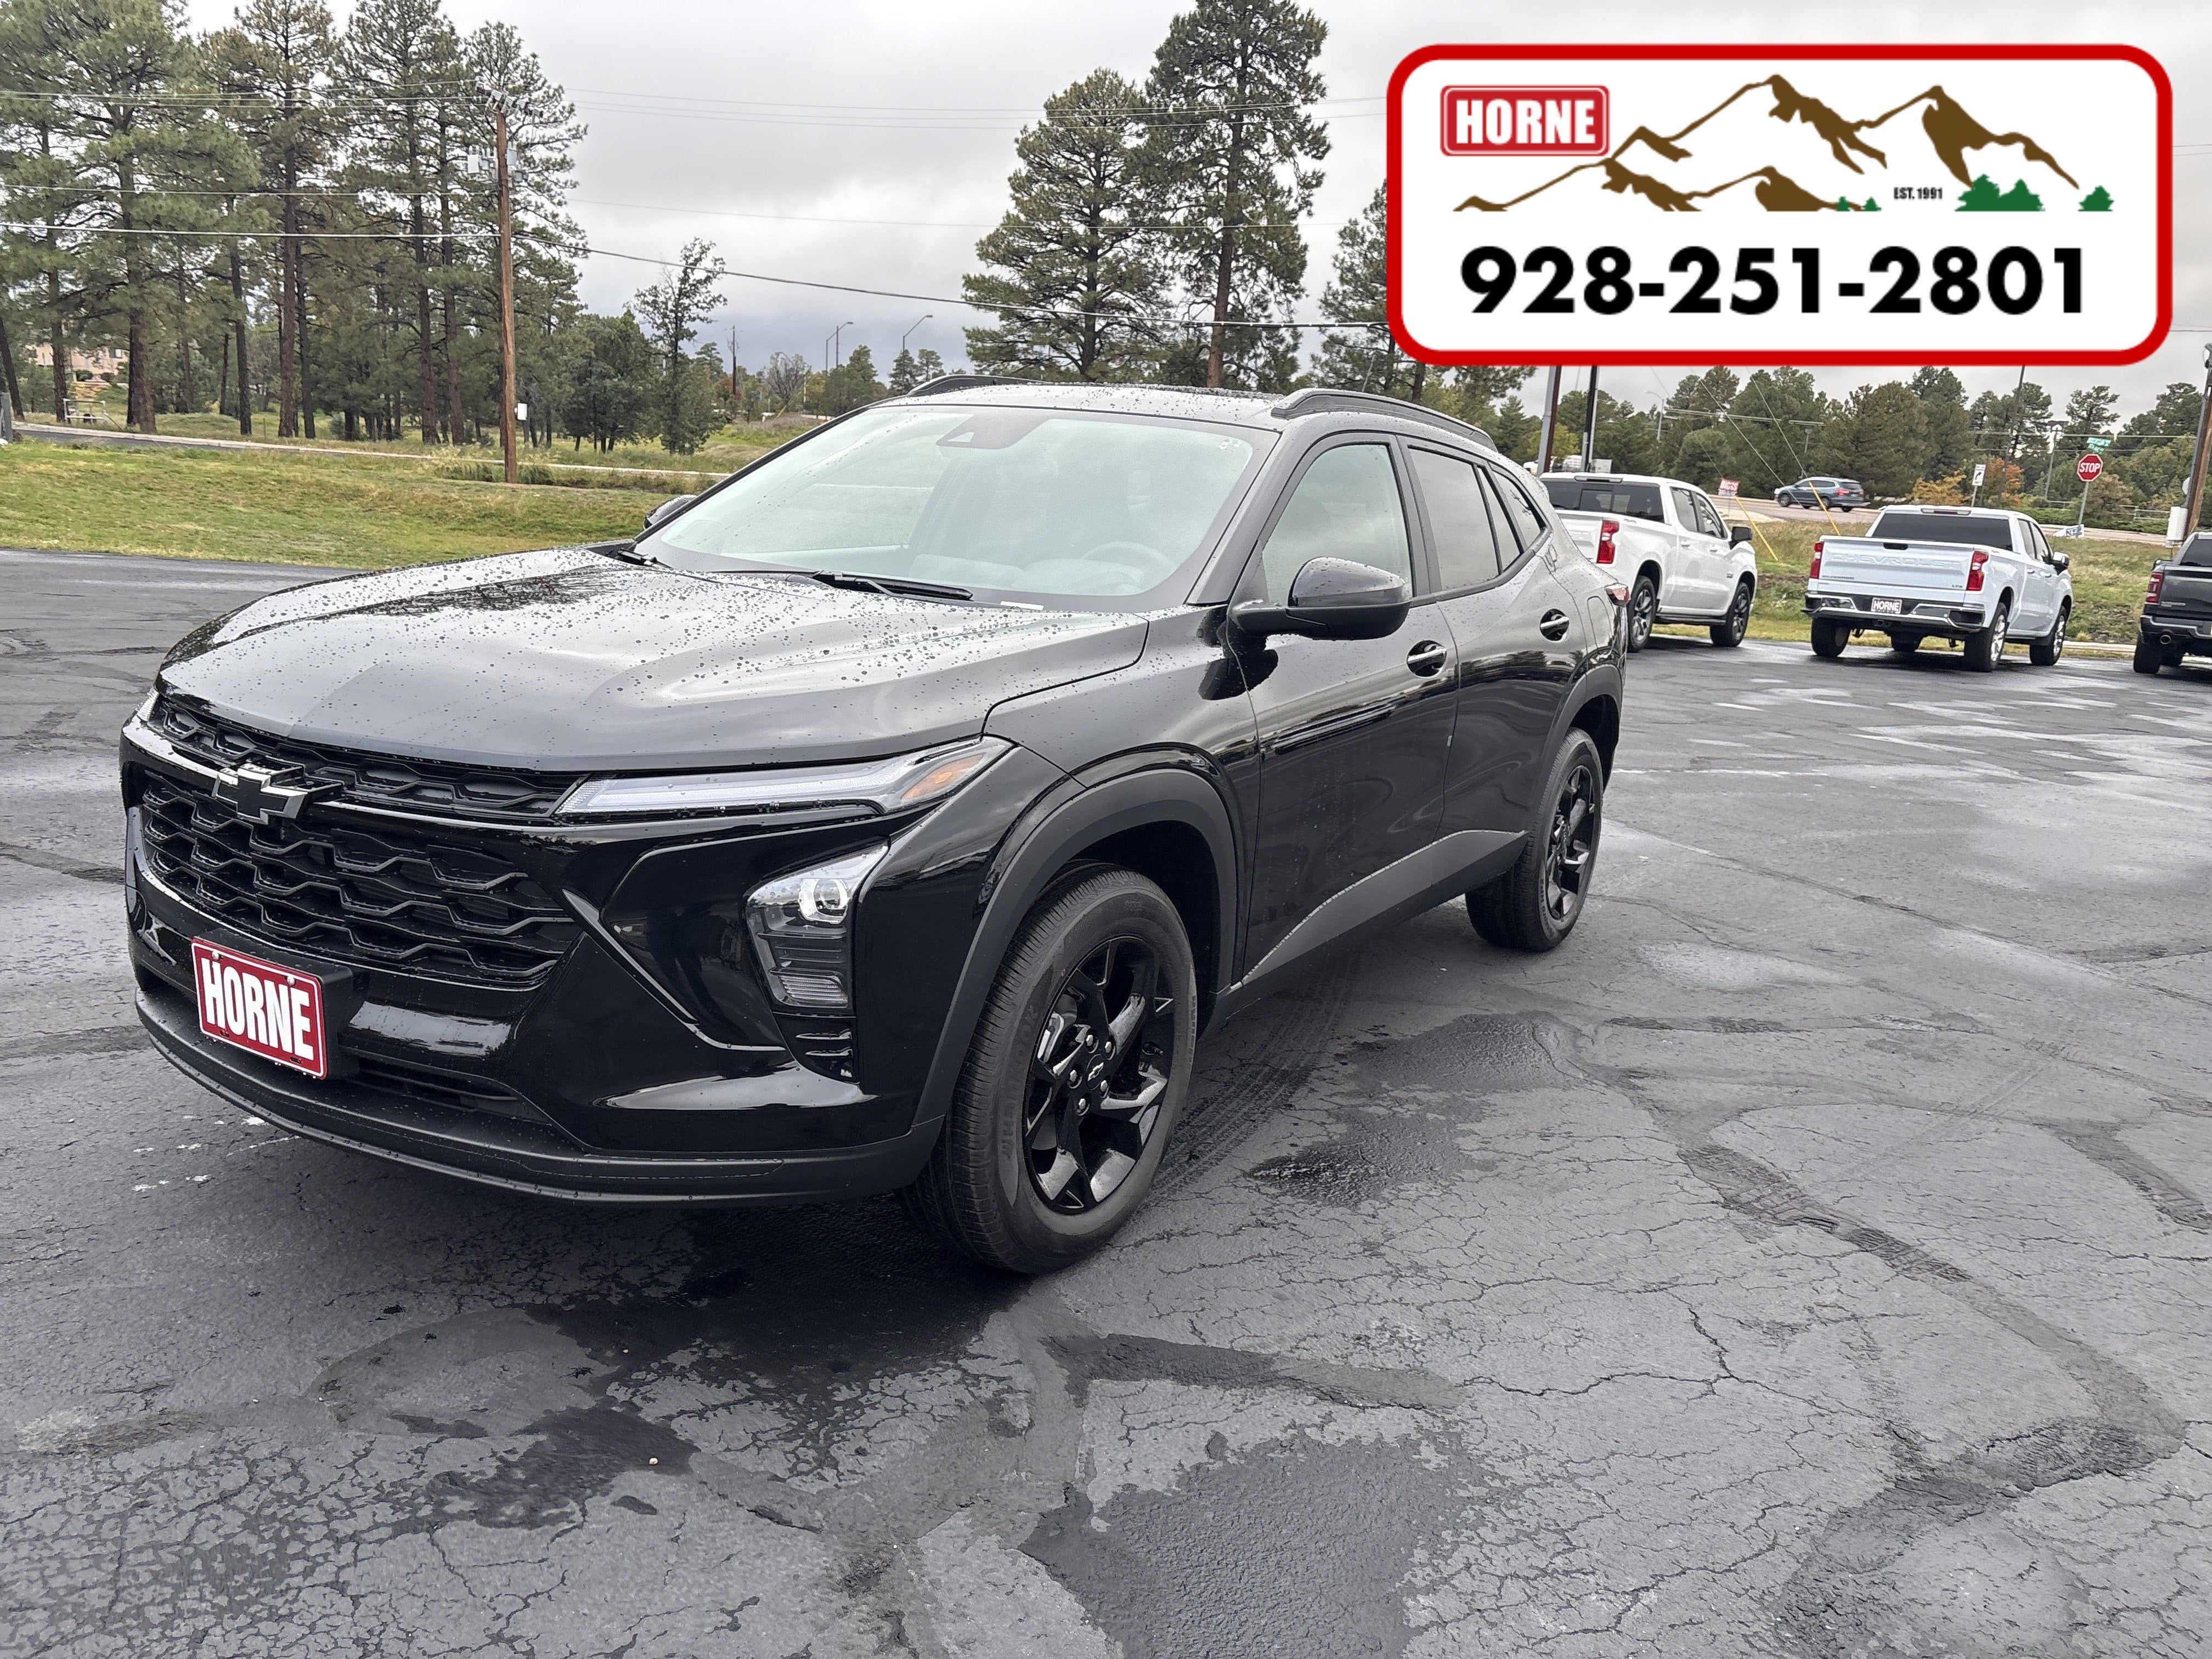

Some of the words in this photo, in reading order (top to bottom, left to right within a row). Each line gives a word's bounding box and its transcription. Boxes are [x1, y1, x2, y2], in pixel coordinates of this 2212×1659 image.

[2079, 462, 2101, 473] STOP
[1873, 600, 1900, 612] HORNE
[201, 957, 314, 1061] HORNE
